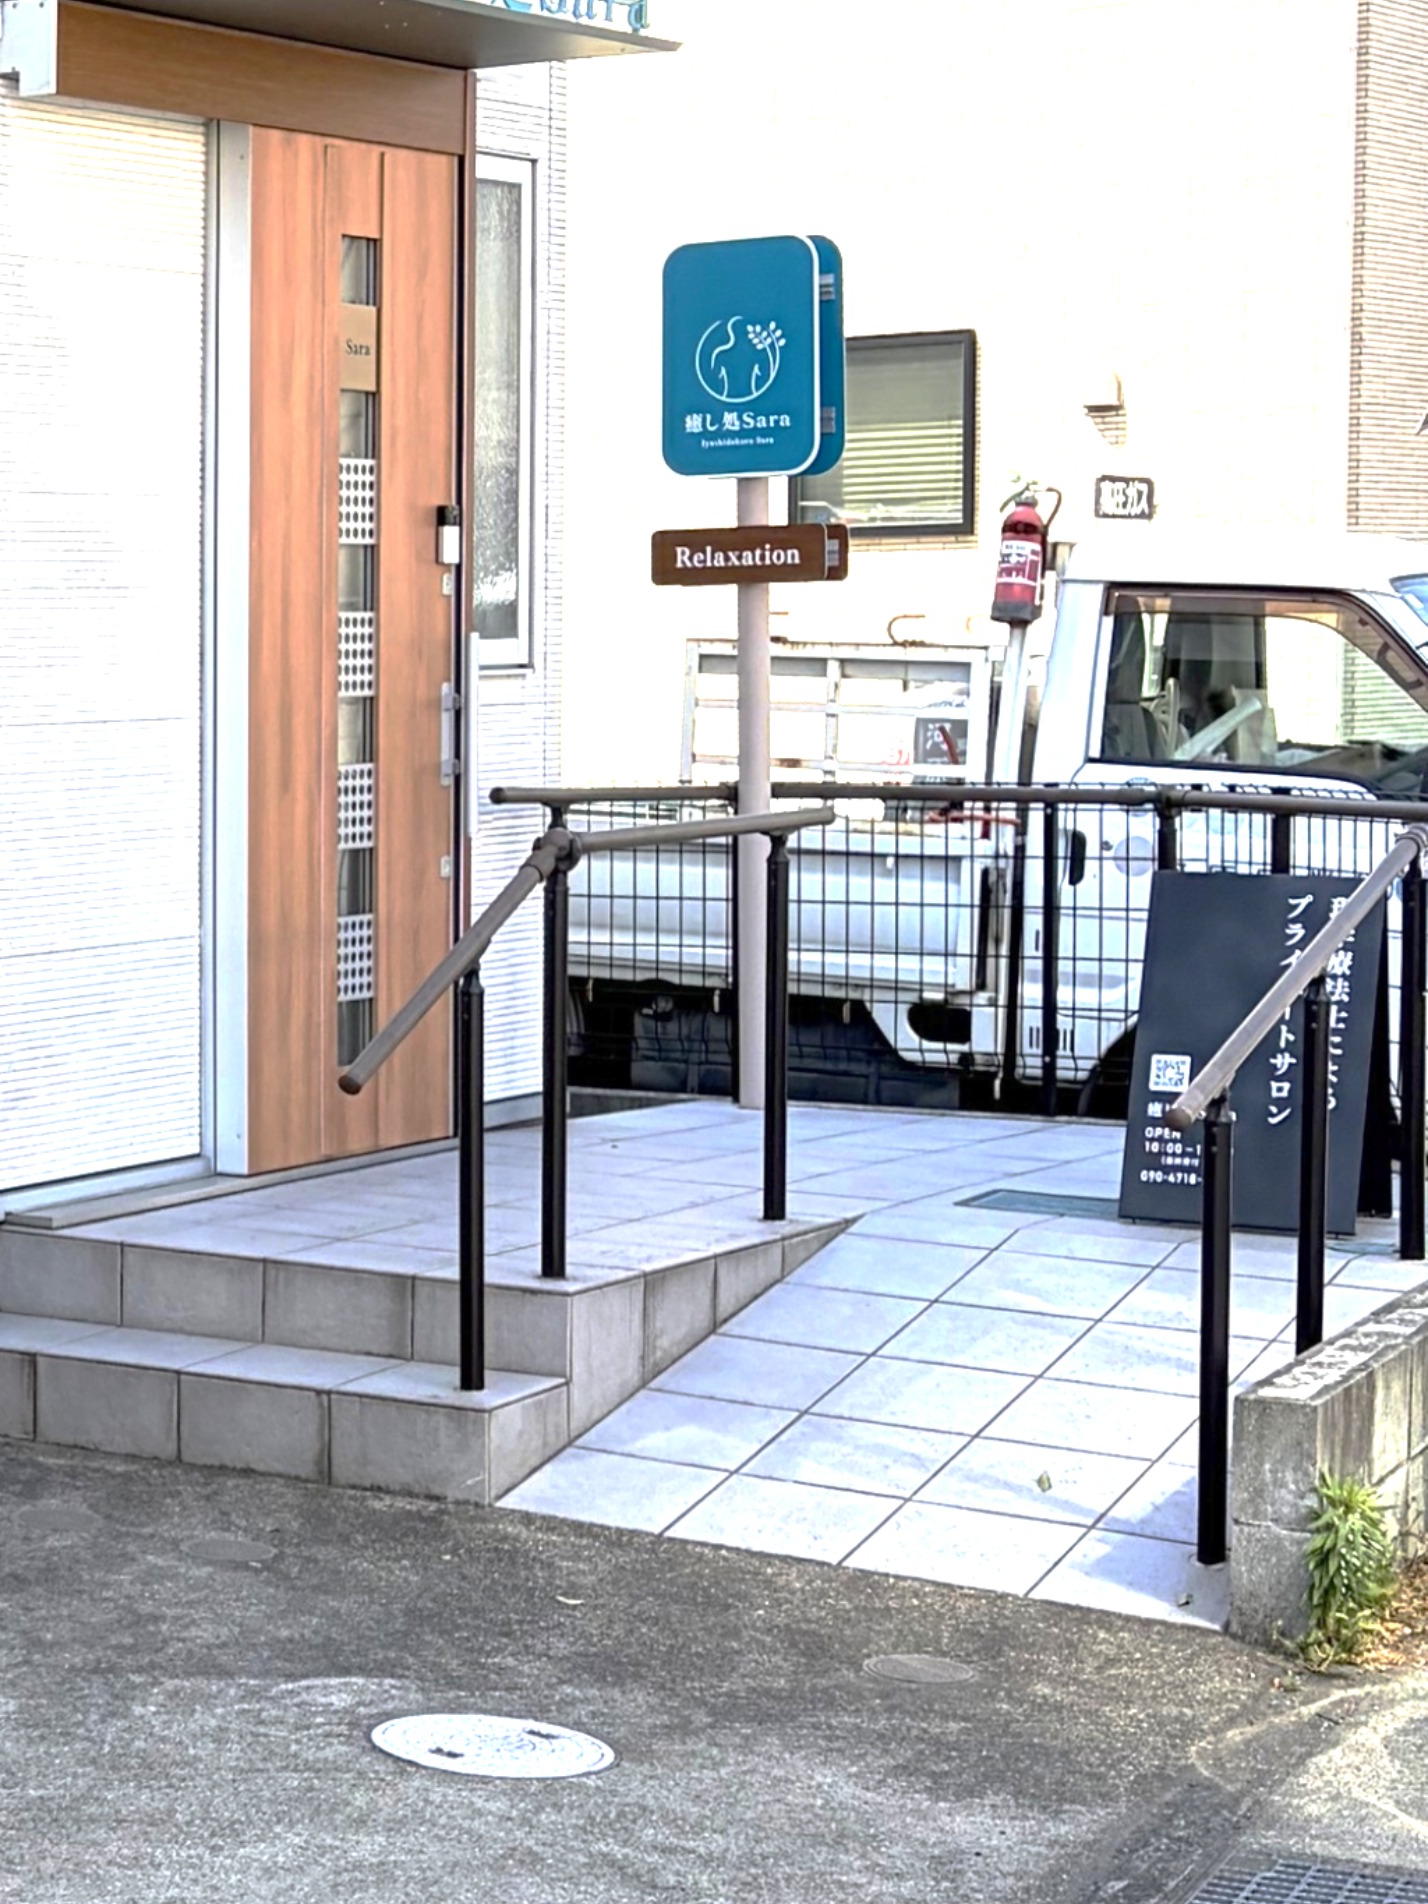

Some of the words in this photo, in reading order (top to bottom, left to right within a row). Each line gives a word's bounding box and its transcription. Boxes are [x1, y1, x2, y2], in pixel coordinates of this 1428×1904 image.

[345, 337, 371, 356] Sara
[685, 411, 791, 434] 癒し処Sara
[675, 543, 801, 568] Relaxation
[1266, 894, 1314, 1125] プライートサロン
[1145, 1126, 1182, 1140] OPEN
